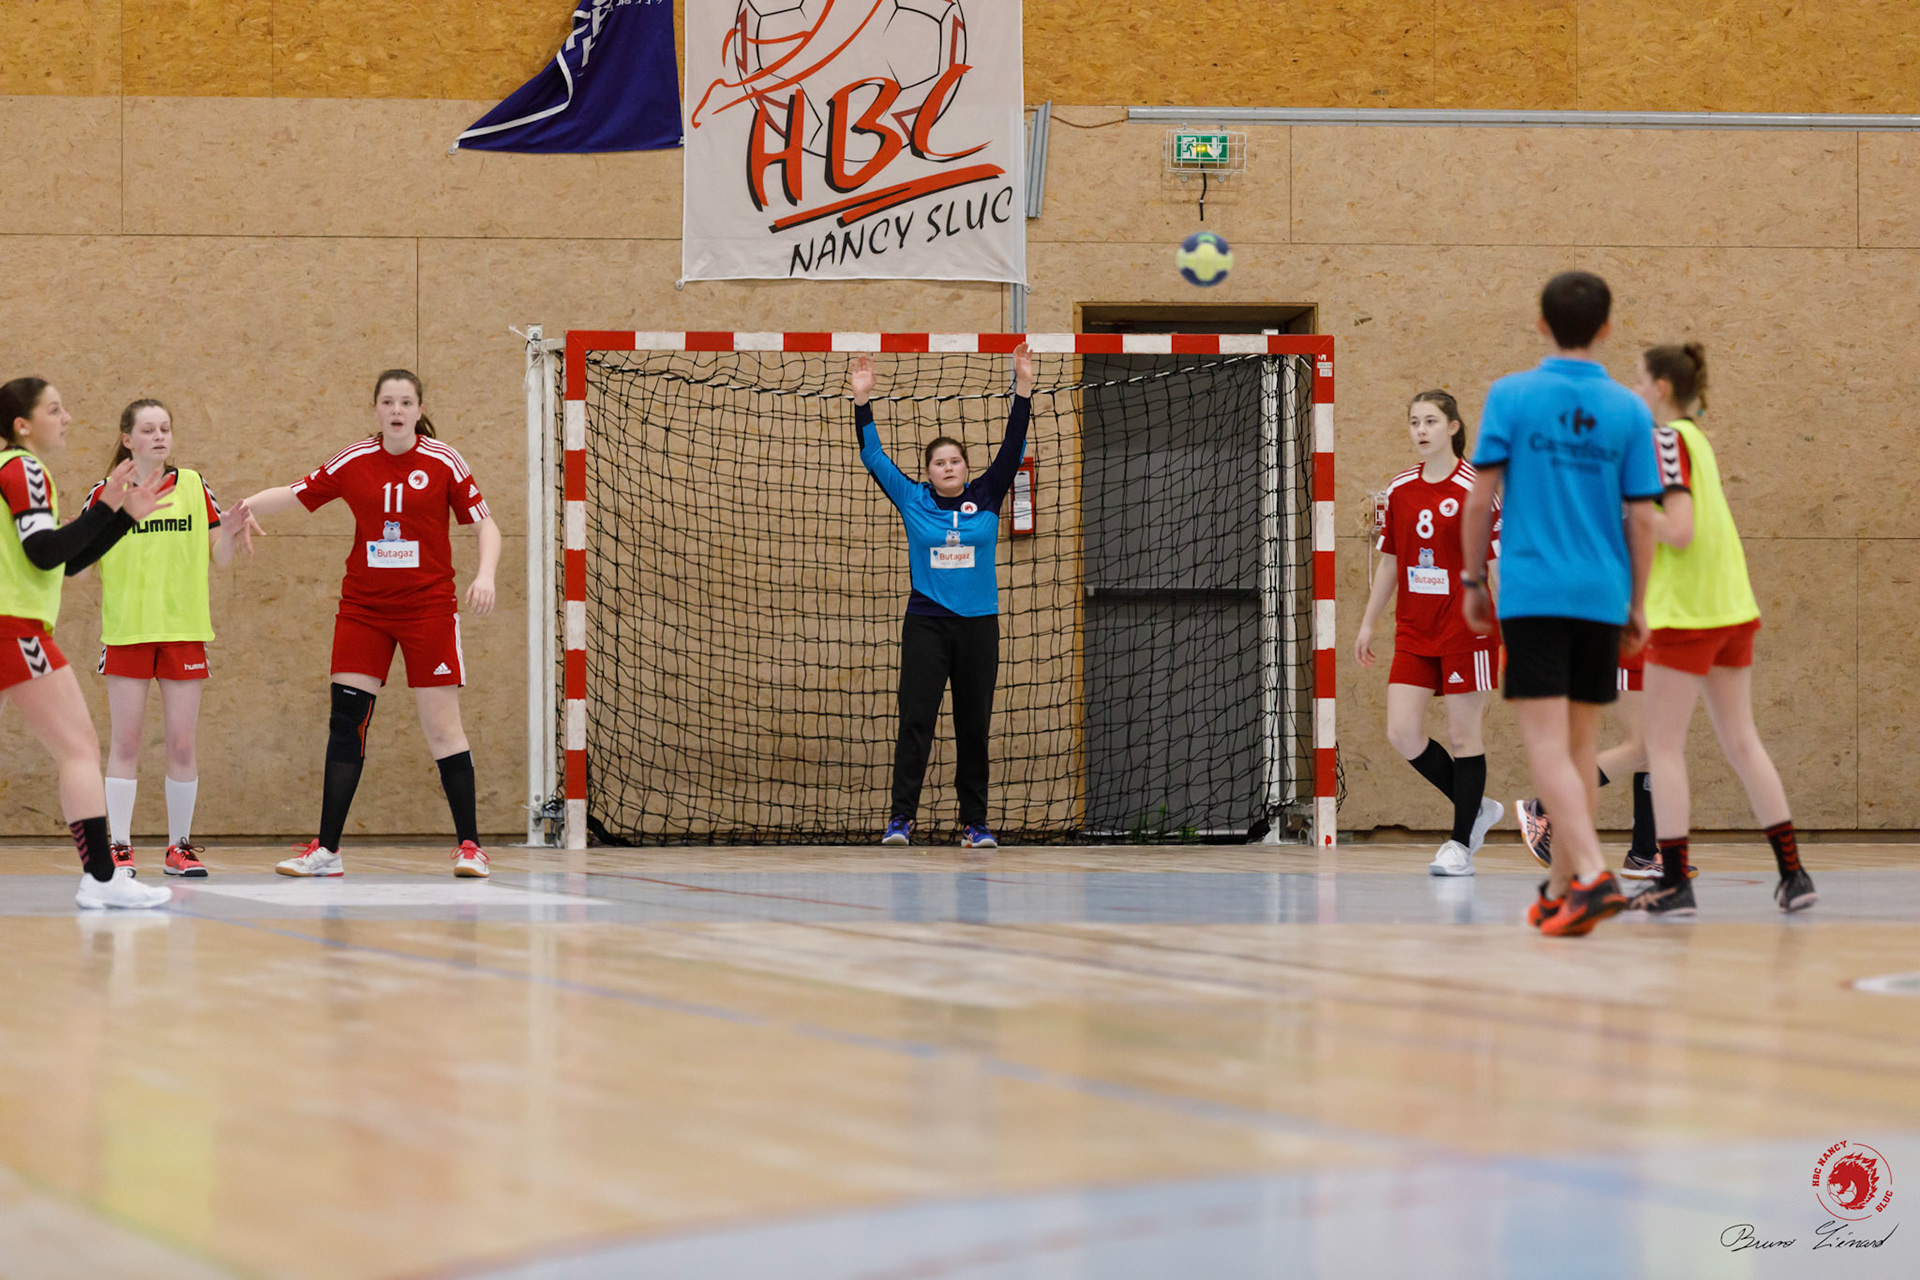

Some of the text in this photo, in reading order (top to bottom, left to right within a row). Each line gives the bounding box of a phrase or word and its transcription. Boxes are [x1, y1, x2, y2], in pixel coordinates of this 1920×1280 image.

[746, 63, 993, 212] HBC
[789, 186, 1013, 277] NANCY SLUC
[382, 482, 404, 513] 11
[1415, 508, 1435, 539] 8
[377, 548, 414, 560] Butagaz
[939, 552, 970, 561] Butagaz
[1414, 574, 1446, 586] Butagaz
